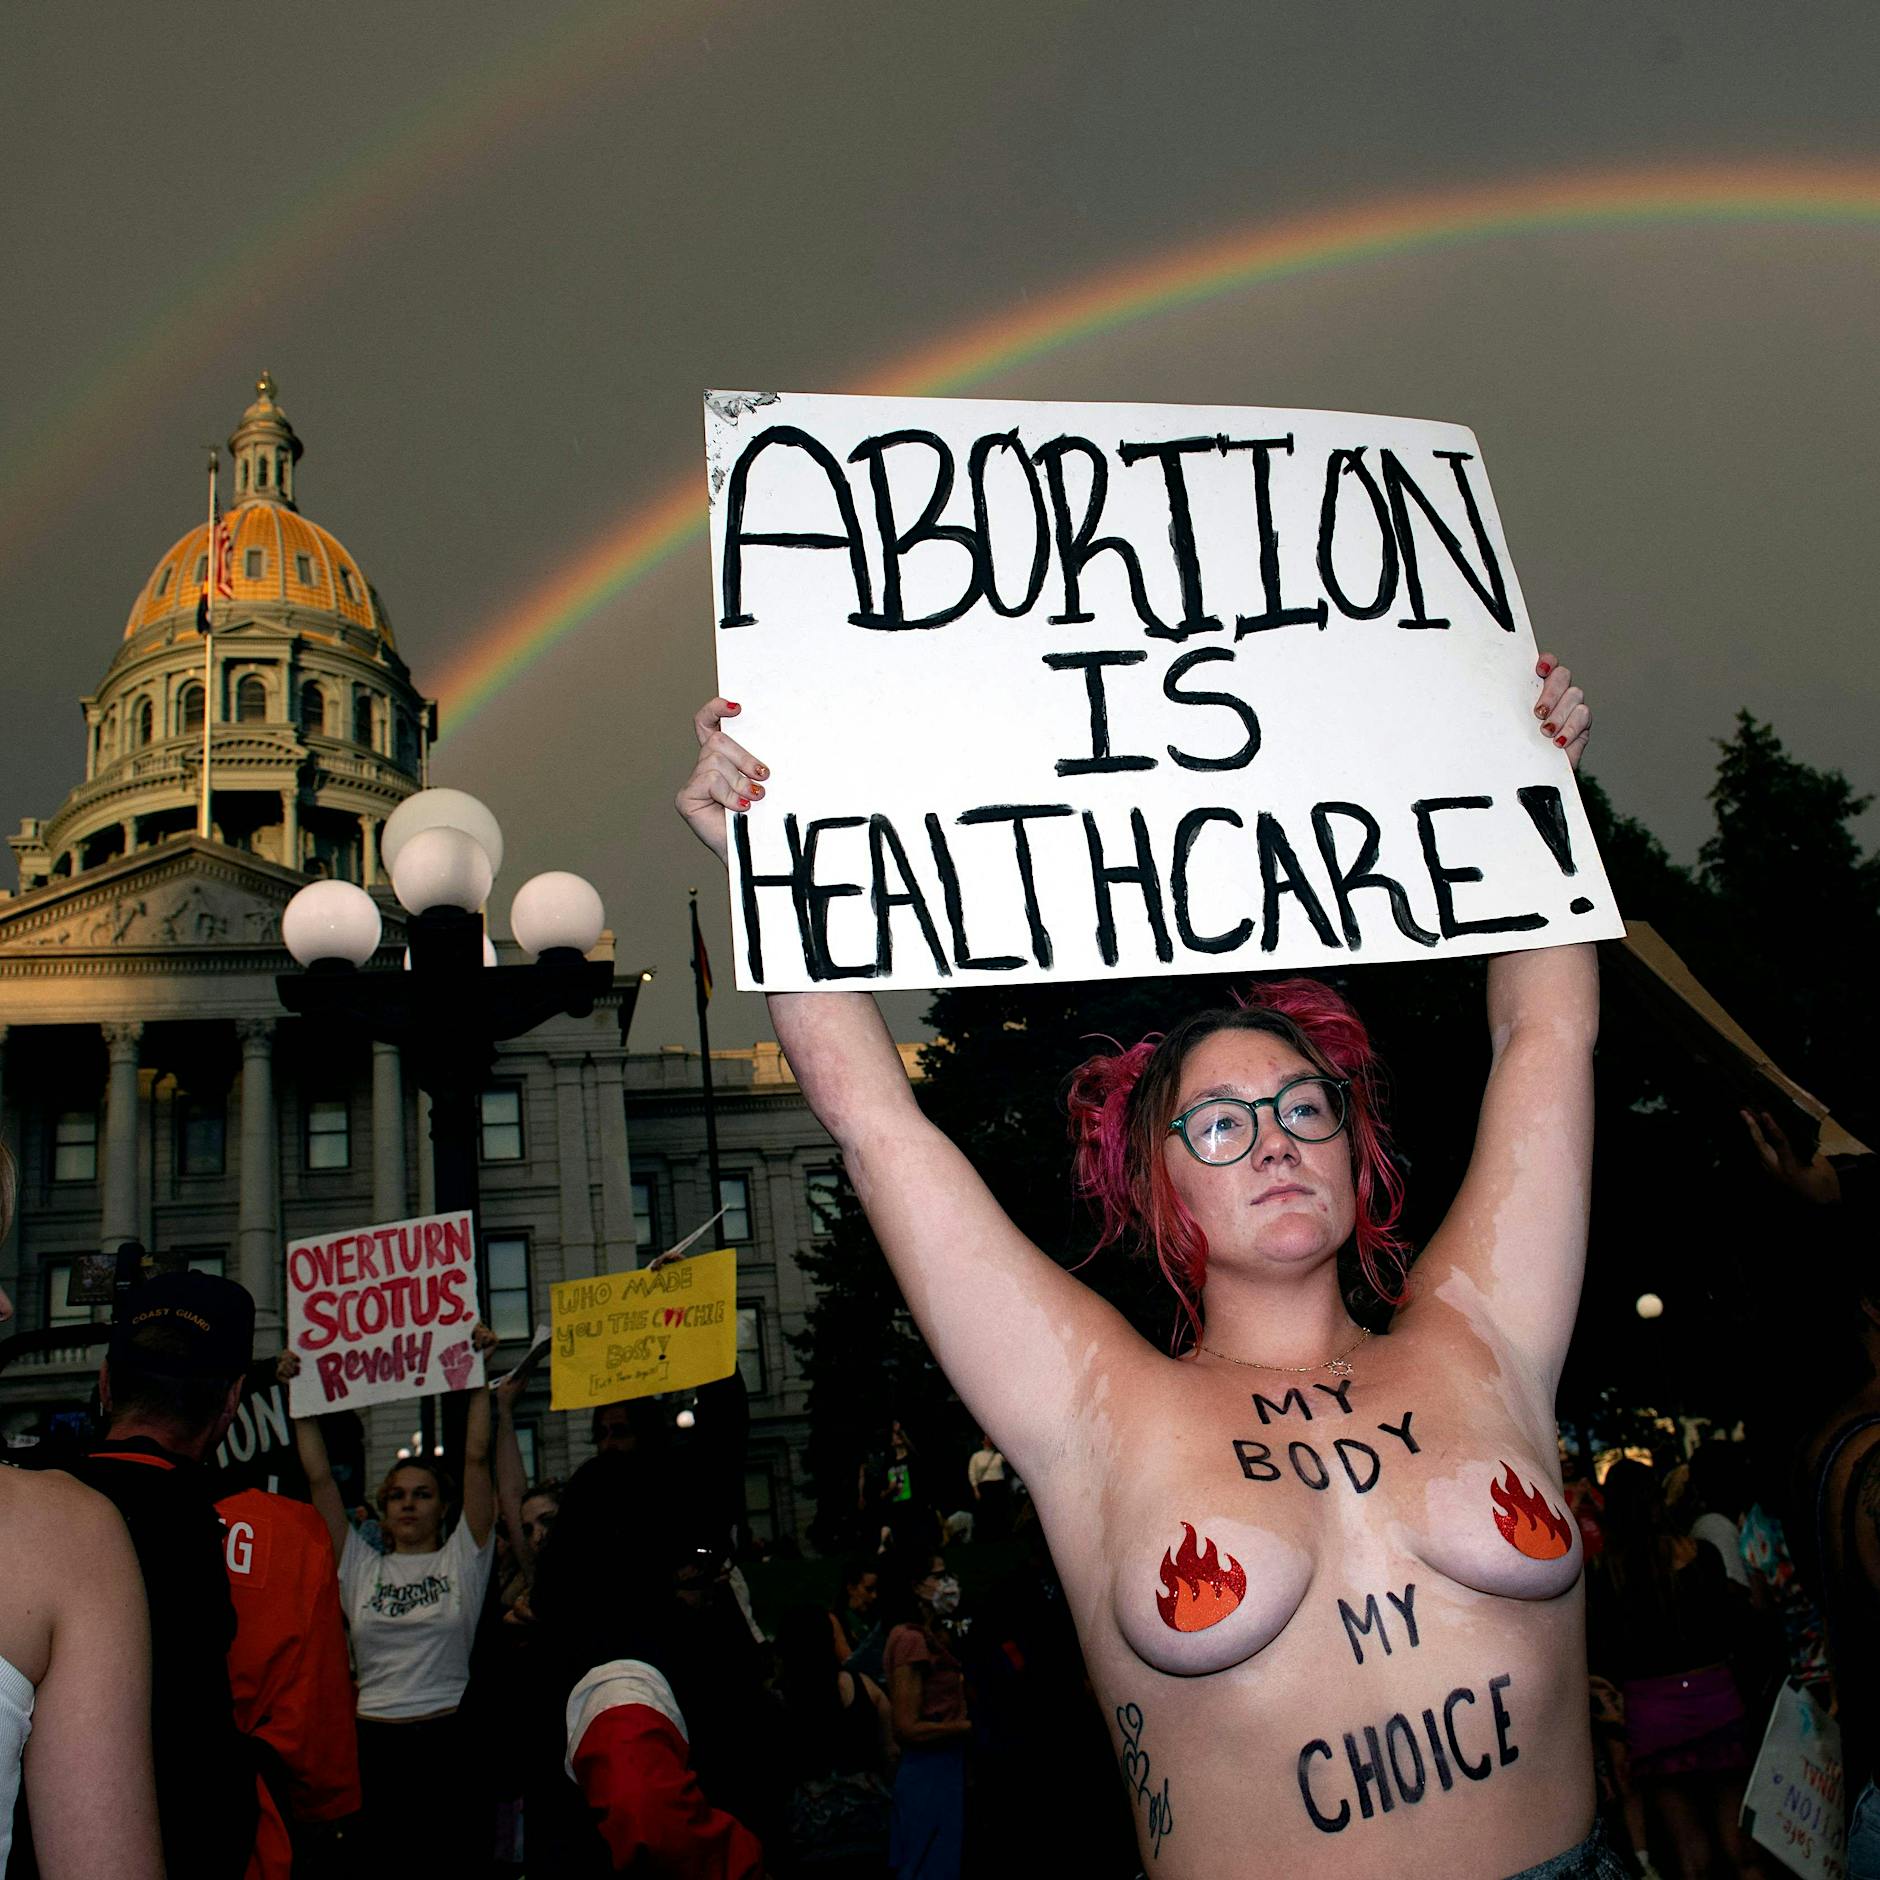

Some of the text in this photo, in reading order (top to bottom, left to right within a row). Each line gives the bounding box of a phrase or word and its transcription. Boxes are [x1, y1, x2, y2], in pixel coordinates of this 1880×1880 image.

[720, 424, 1516, 641] ABORTION
[1042, 645, 1264, 776] IS
[733, 784, 1596, 984] HEALTHCARE!
[289, 1217, 471, 1292] OVERTURN
[557, 1267, 693, 1315] WHO MADE
[131, 1308, 211, 1332] COAST GUARD
[297, 1268, 474, 1350] SCOTUS.
[608, 1310, 649, 1335] THE
[316, 1331, 433, 1402] Revolt!
[1251, 1379, 1353, 1425] MY
[1232, 1410, 1422, 1494] BODY
[219, 1519, 256, 1575] G
[1337, 1582, 1420, 1665] MY
[1297, 1672, 1520, 1834] CHOICE
